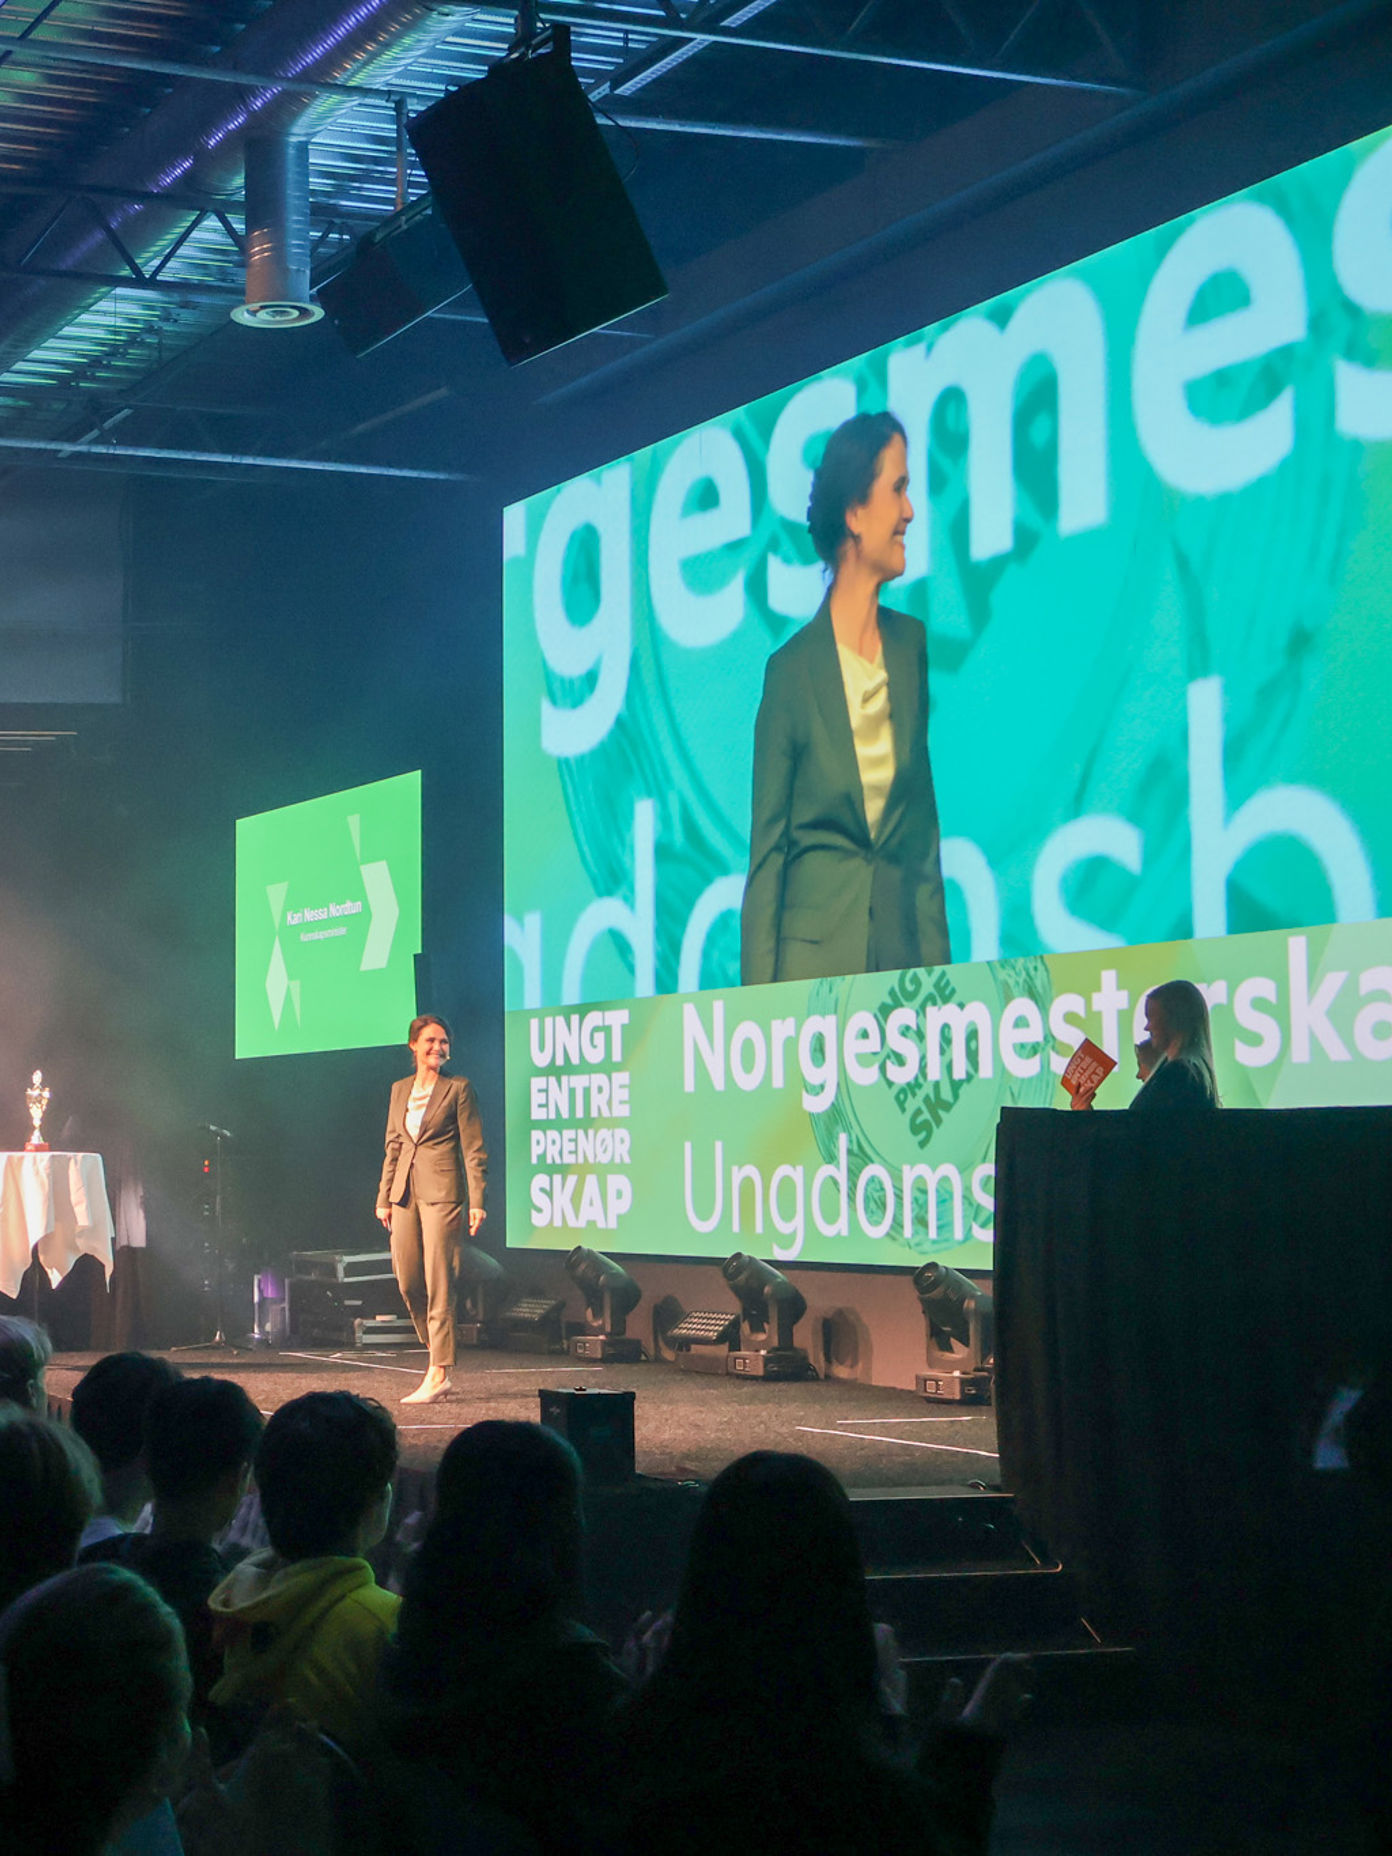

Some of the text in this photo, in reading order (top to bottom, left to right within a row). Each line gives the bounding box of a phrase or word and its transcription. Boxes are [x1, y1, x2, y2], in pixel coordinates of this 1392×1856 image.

[304, 906, 328, 922] Nessa
[529, 1009, 629, 1068] UNGT
[530, 1071, 631, 1120] ENTRE
[530, 1128, 631, 1164] PRENØR
[530, 1173, 633, 1229] SKAP
[684, 1132, 996, 1261] Ungdoms
